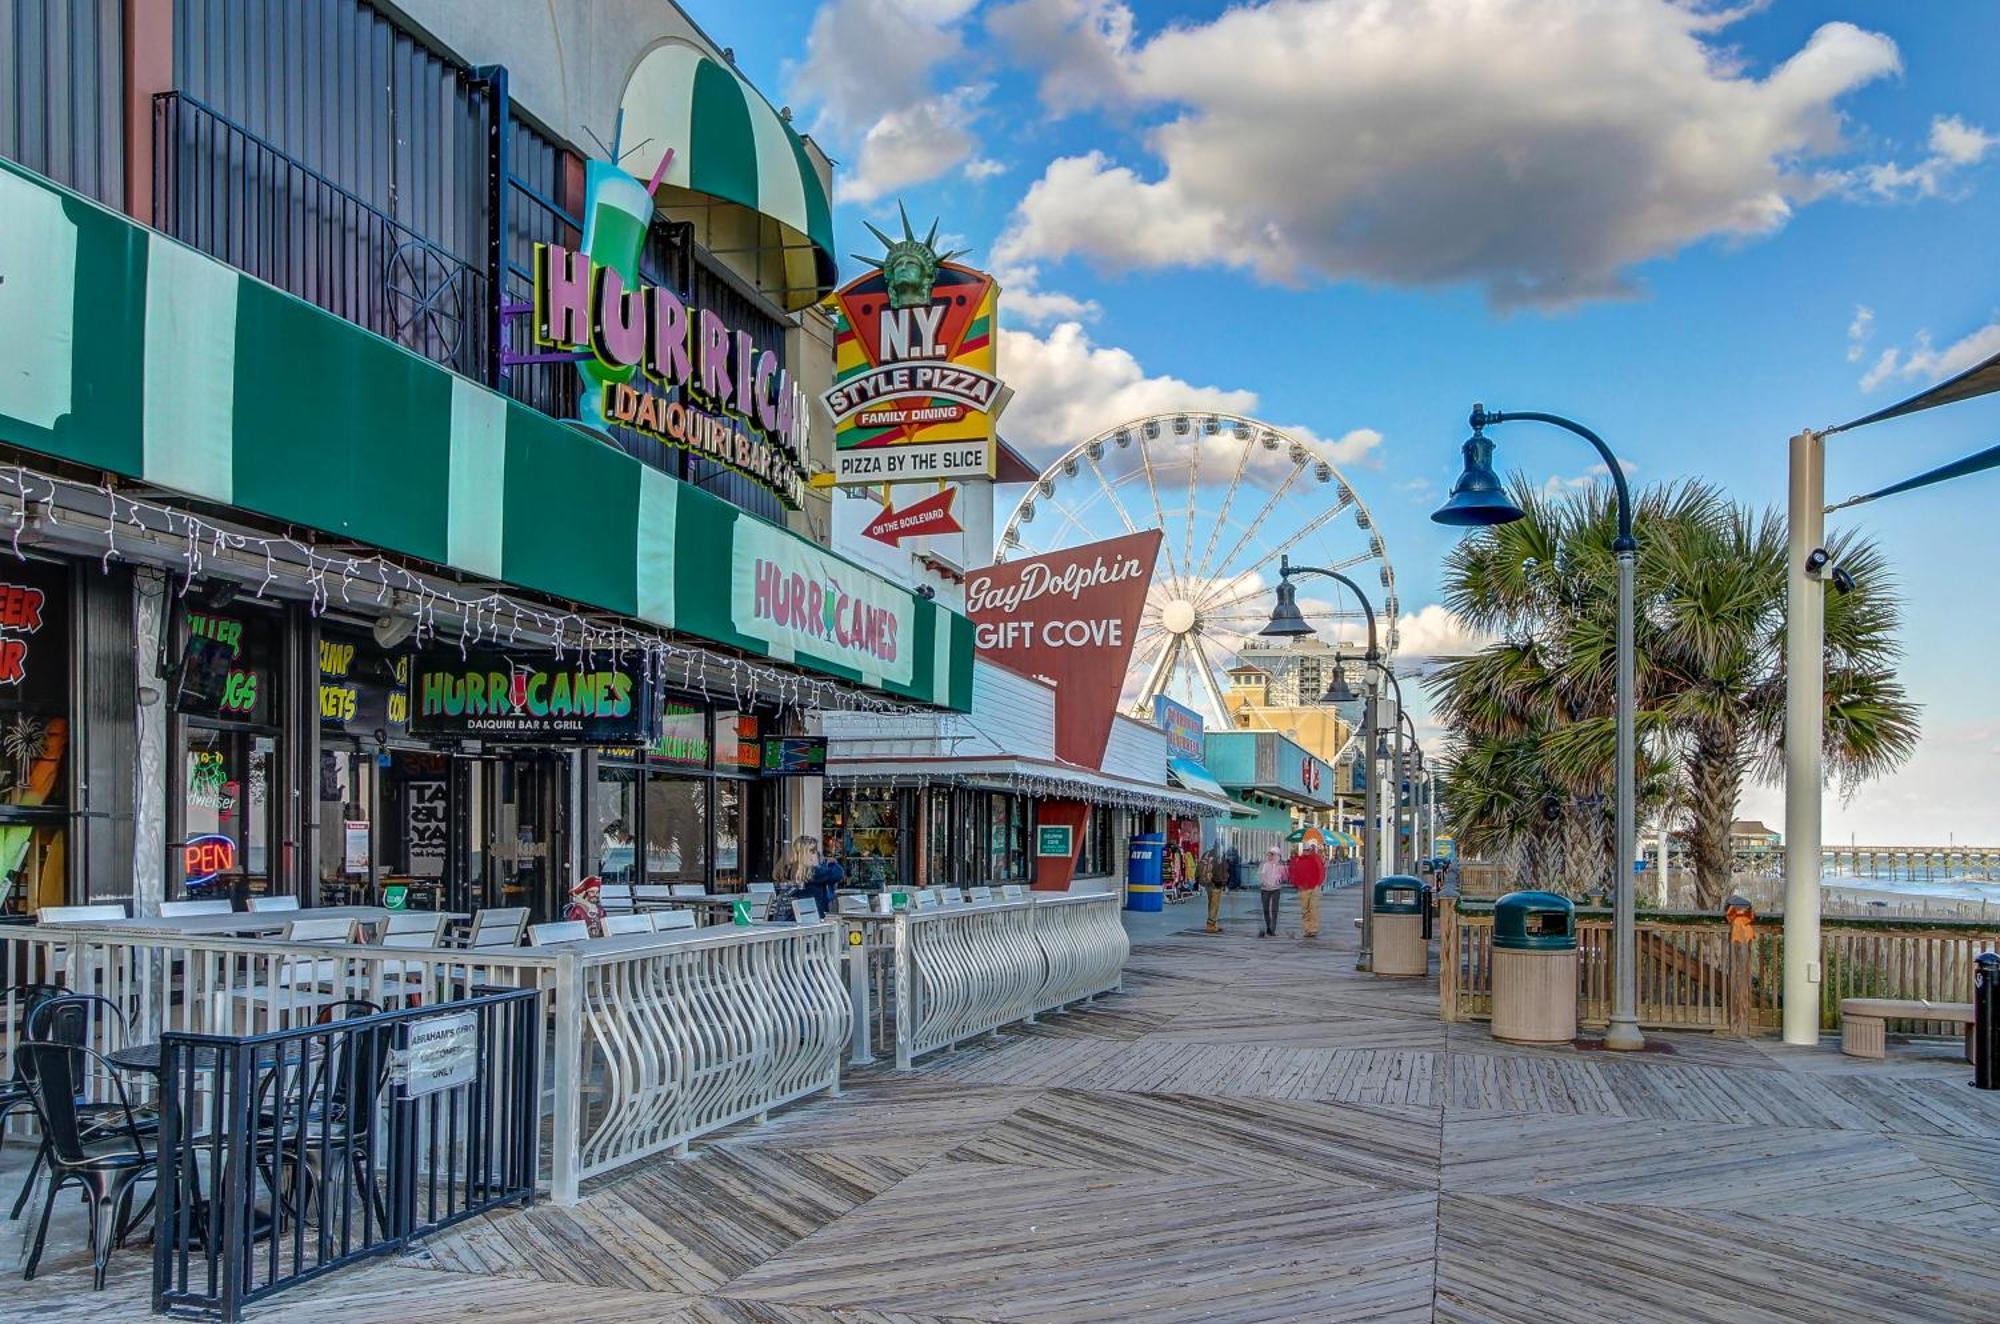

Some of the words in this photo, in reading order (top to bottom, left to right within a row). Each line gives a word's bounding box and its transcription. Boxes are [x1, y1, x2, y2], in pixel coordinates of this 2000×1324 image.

[880, 305, 947, 362] N.Y.
[829, 369, 910, 412] STYLE
[916, 368, 989, 402] PIZZA
[603, 381, 734, 462] DAIQUIRI
[862, 411, 907, 424] FAMILY
[911, 407, 957, 420] DINING
[841, 457, 881, 474] PIZZA
[887, 455, 905, 472] BY
[911, 453, 937, 470] THE
[943, 450, 982, 467] SLICE
[872, 524, 884, 535] ON
[884, 520, 899, 532] THE
[900, 508, 944, 529] BOULEVARD
[754, 558, 898, 663] HURRICANES
[974, 620, 1035, 648] GIFT
[1042, 619, 1122, 647] COVE
[421, 671, 633, 719] HURRICANES
[467, 719, 516, 730] DAIQUIRI
[518, 720, 540, 730] BAR
[543, 720, 550, 730] &
[552, 720, 583, 730] GRILL
[1131, 851, 1152, 860] ATM
